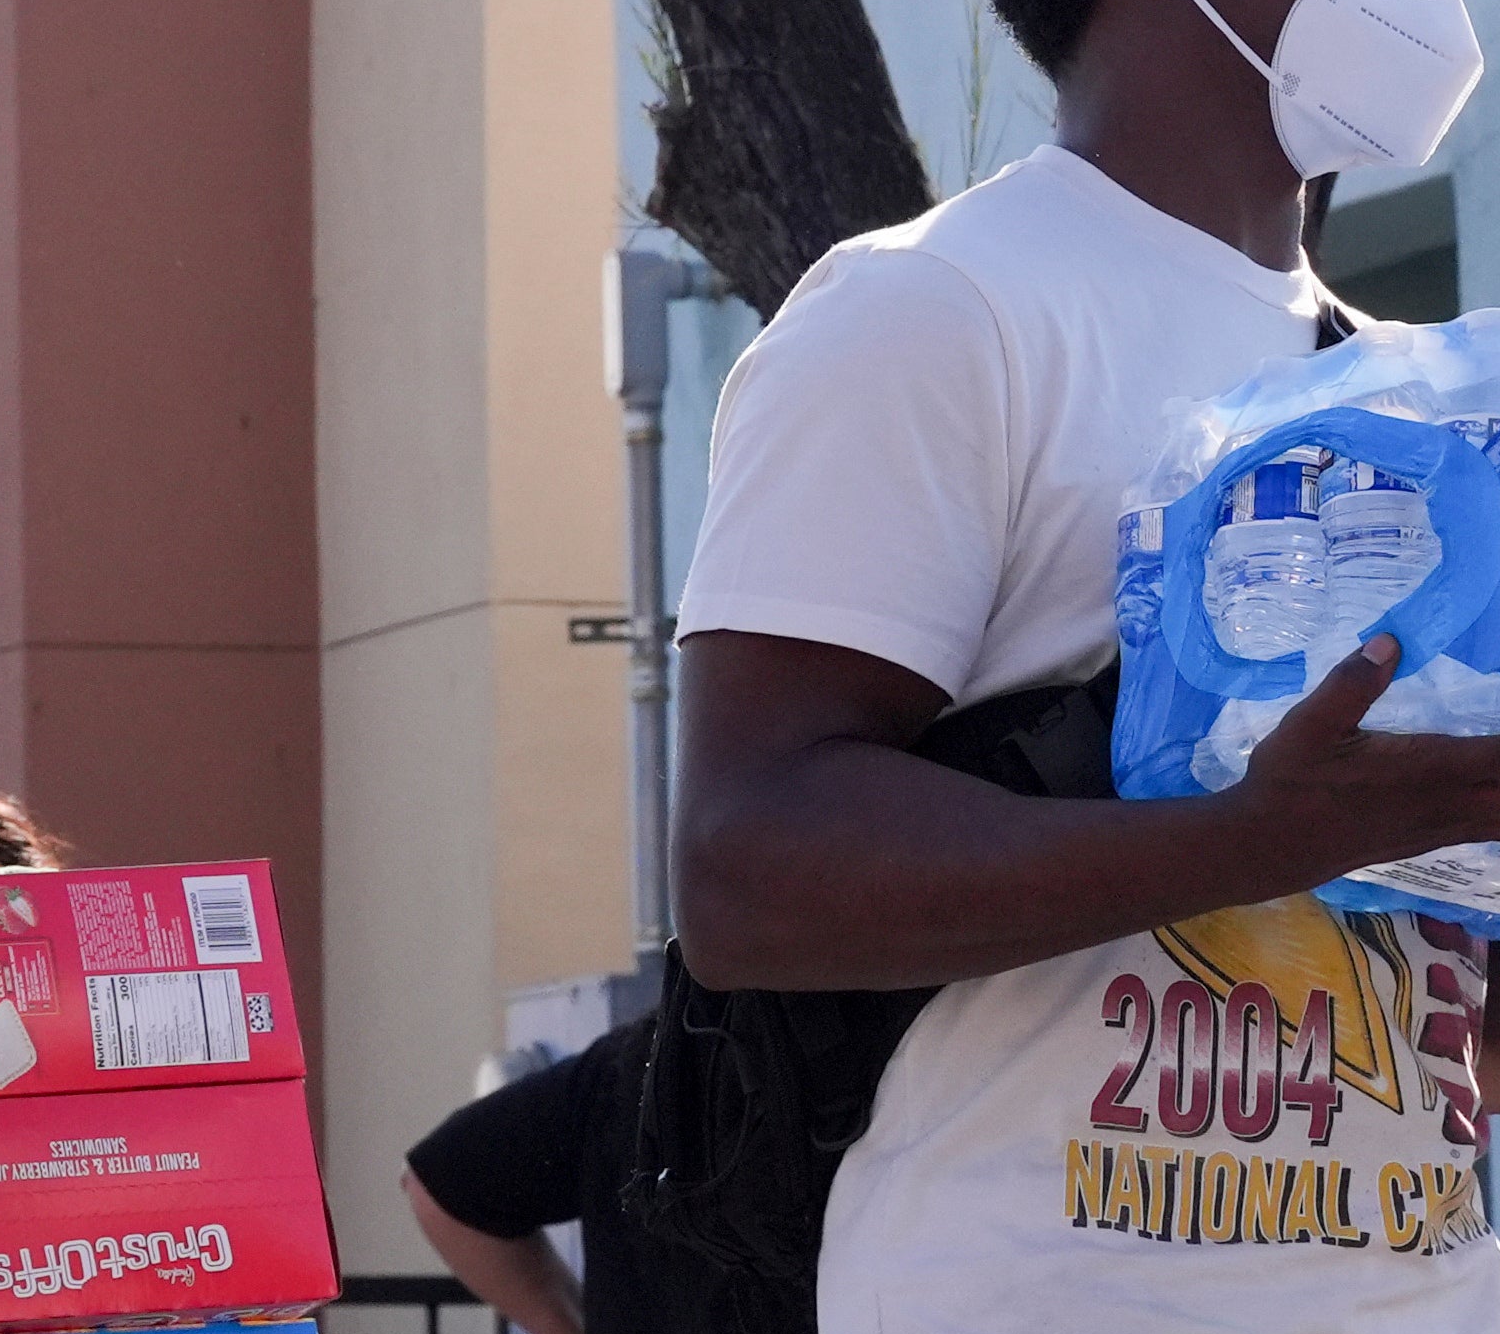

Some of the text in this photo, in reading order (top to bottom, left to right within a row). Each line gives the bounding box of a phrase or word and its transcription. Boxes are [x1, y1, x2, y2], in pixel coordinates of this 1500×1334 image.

[89, 977, 106, 1069] Nutrition Facts
[118, 976, 139, 1066] Calories 300
[1090, 972, 1343, 1147] 2004
[50, 1136, 128, 1158] SANDWICHES
[12, 1158, 90, 1181] STRAWBERRY
[93, 1158, 104, 1175] &
[108, 1155, 151, 1175] BUTTER
[156, 1152, 200, 1171] PEANUT
[1063, 1137, 1369, 1249] NATIONAL
